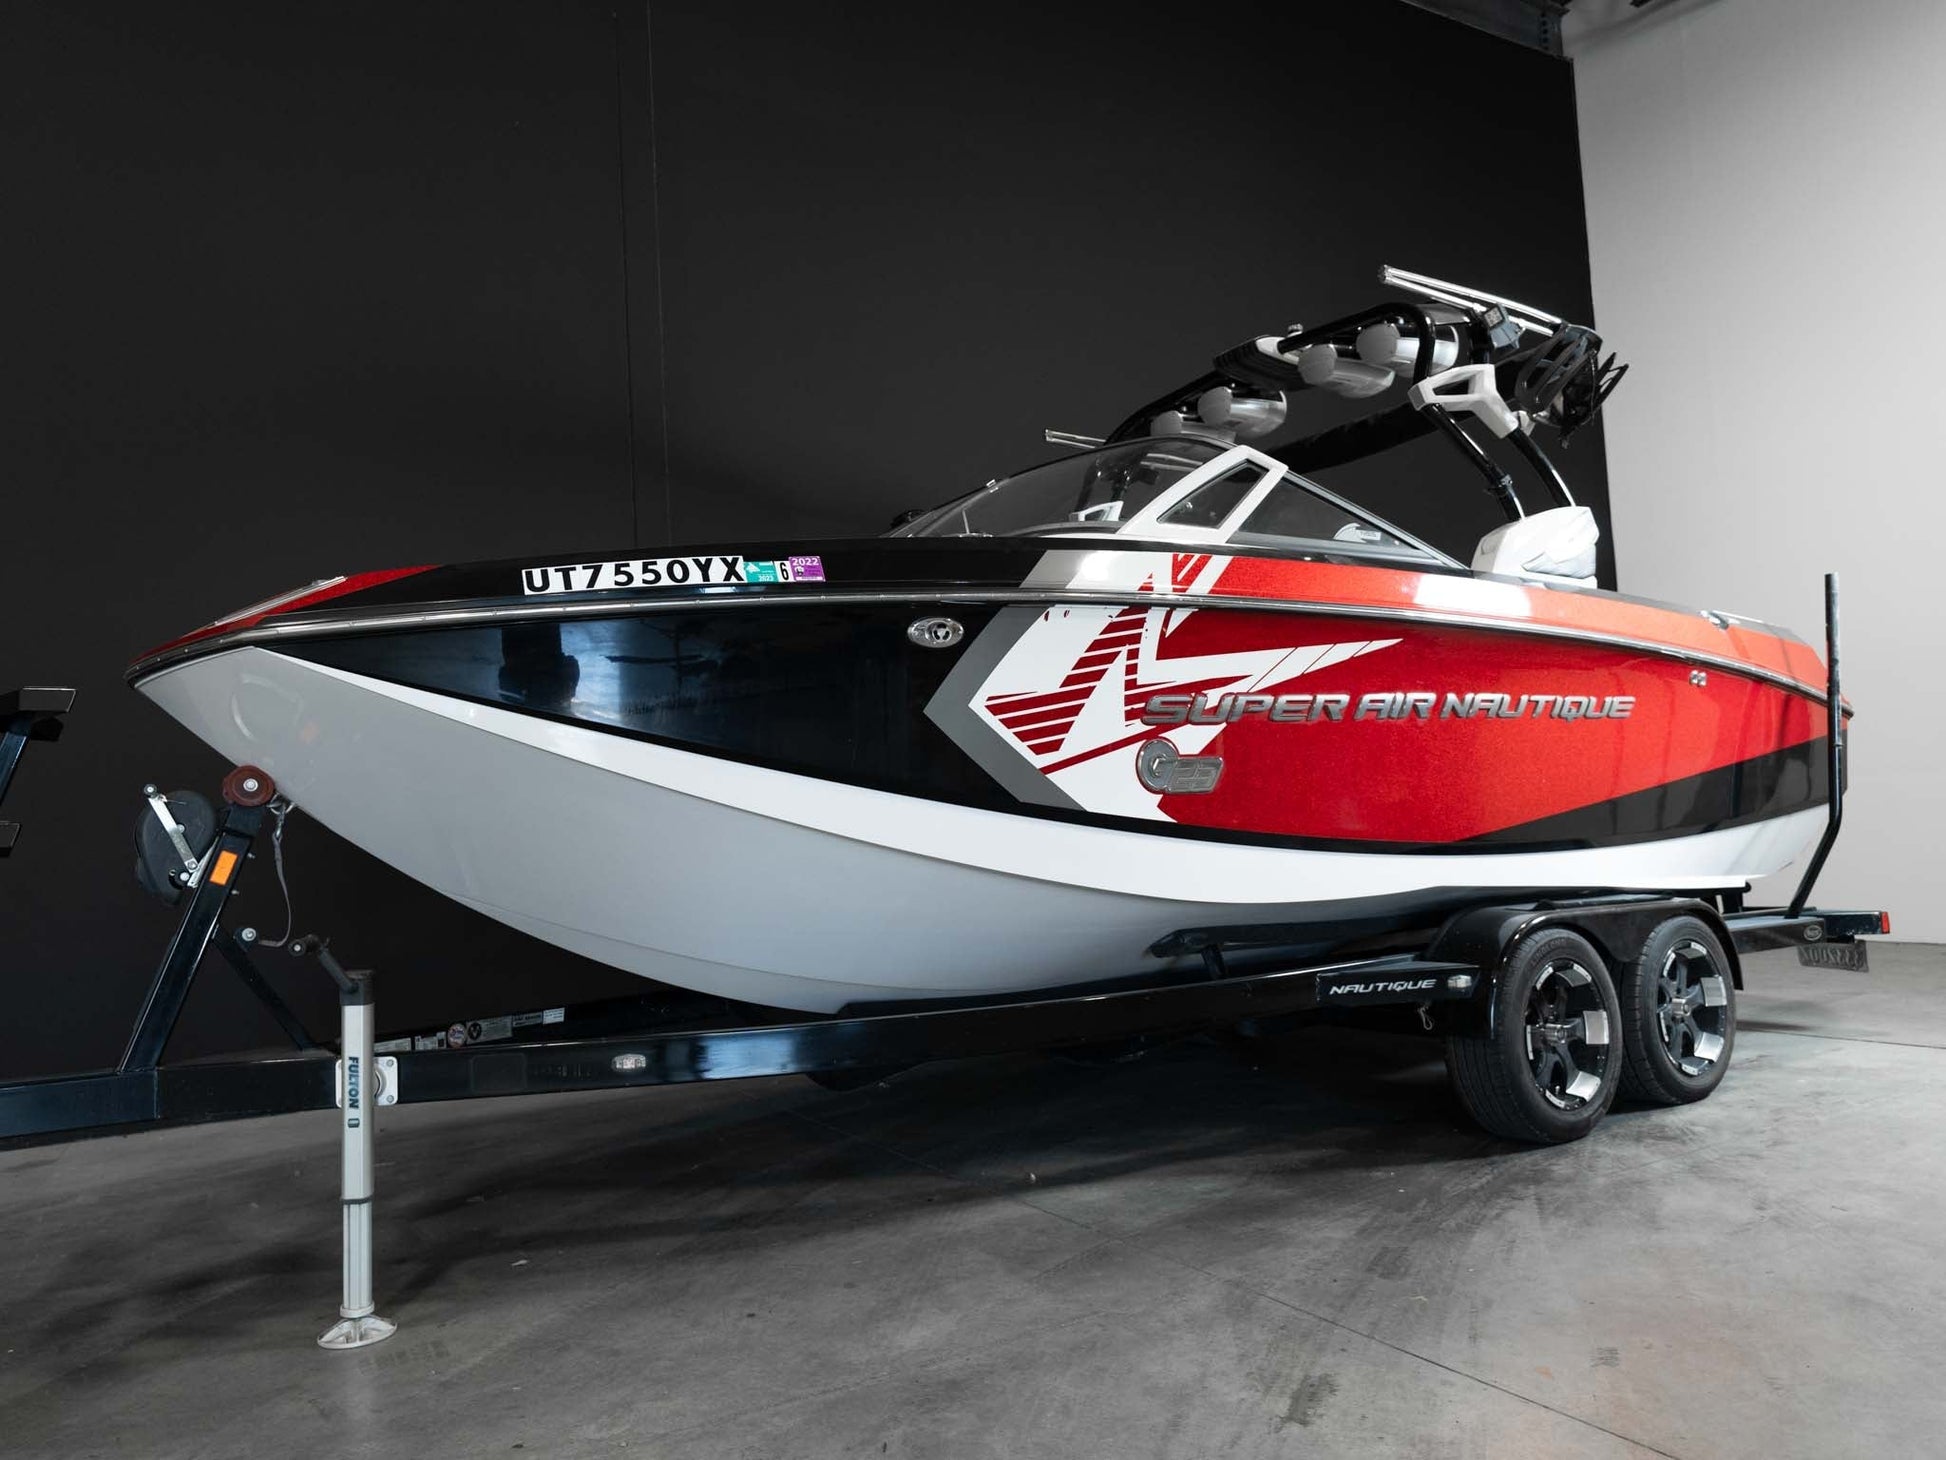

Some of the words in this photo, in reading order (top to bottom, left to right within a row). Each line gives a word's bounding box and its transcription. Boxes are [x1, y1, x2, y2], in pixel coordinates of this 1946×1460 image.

[524, 556, 745, 593] UT7550YX
[779, 561, 789, 581] 6
[791, 557, 820, 566] 2022
[1141, 692, 1350, 725] SUPER
[1353, 692, 1437, 720] AIR
[1440, 693, 1636, 723] NAUTIQUE
[1329, 979, 1438, 995] NAUTIQUE
[348, 1056, 360, 1109] FULTON
